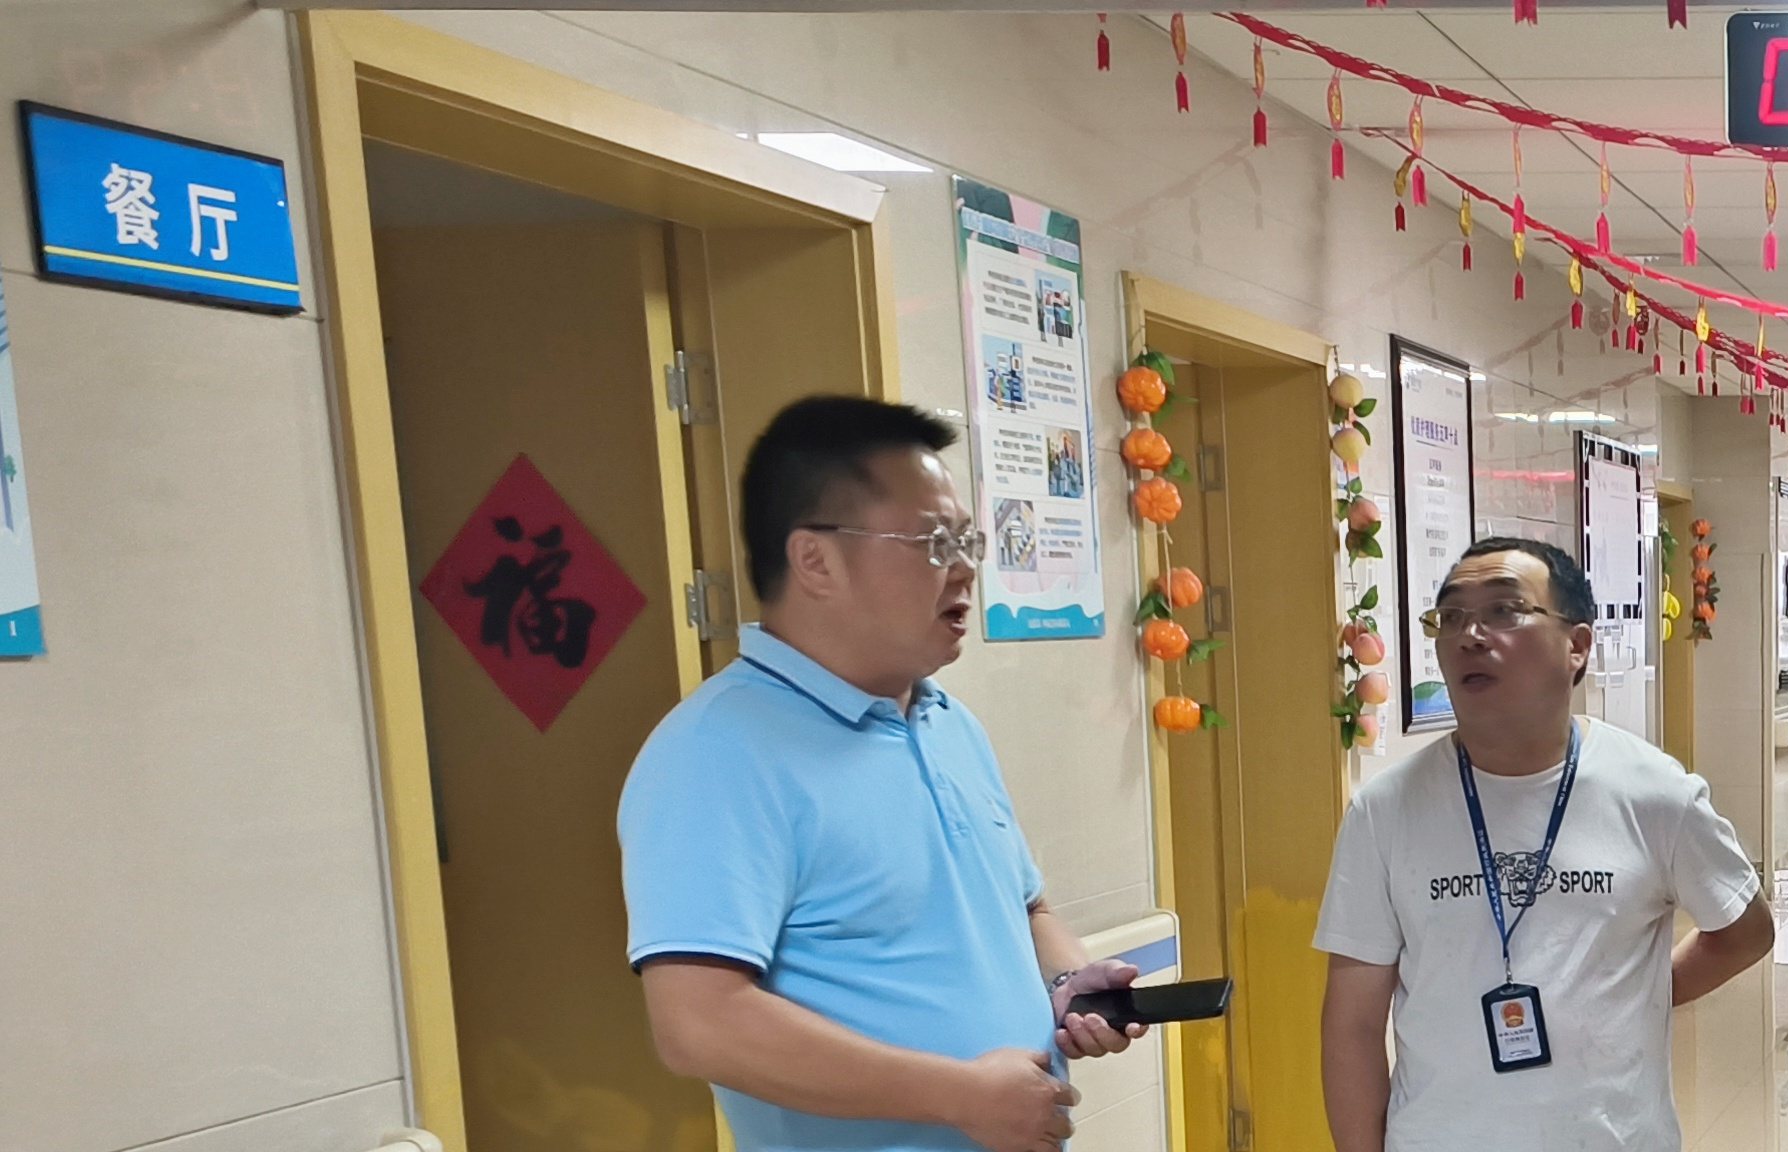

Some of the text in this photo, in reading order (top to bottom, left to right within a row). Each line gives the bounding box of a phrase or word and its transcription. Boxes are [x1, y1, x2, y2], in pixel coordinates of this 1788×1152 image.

[101, 163, 238, 262] 餐厅
[463, 516, 596, 668] 福
[1430, 870, 1614, 900] SPORT SPORT
